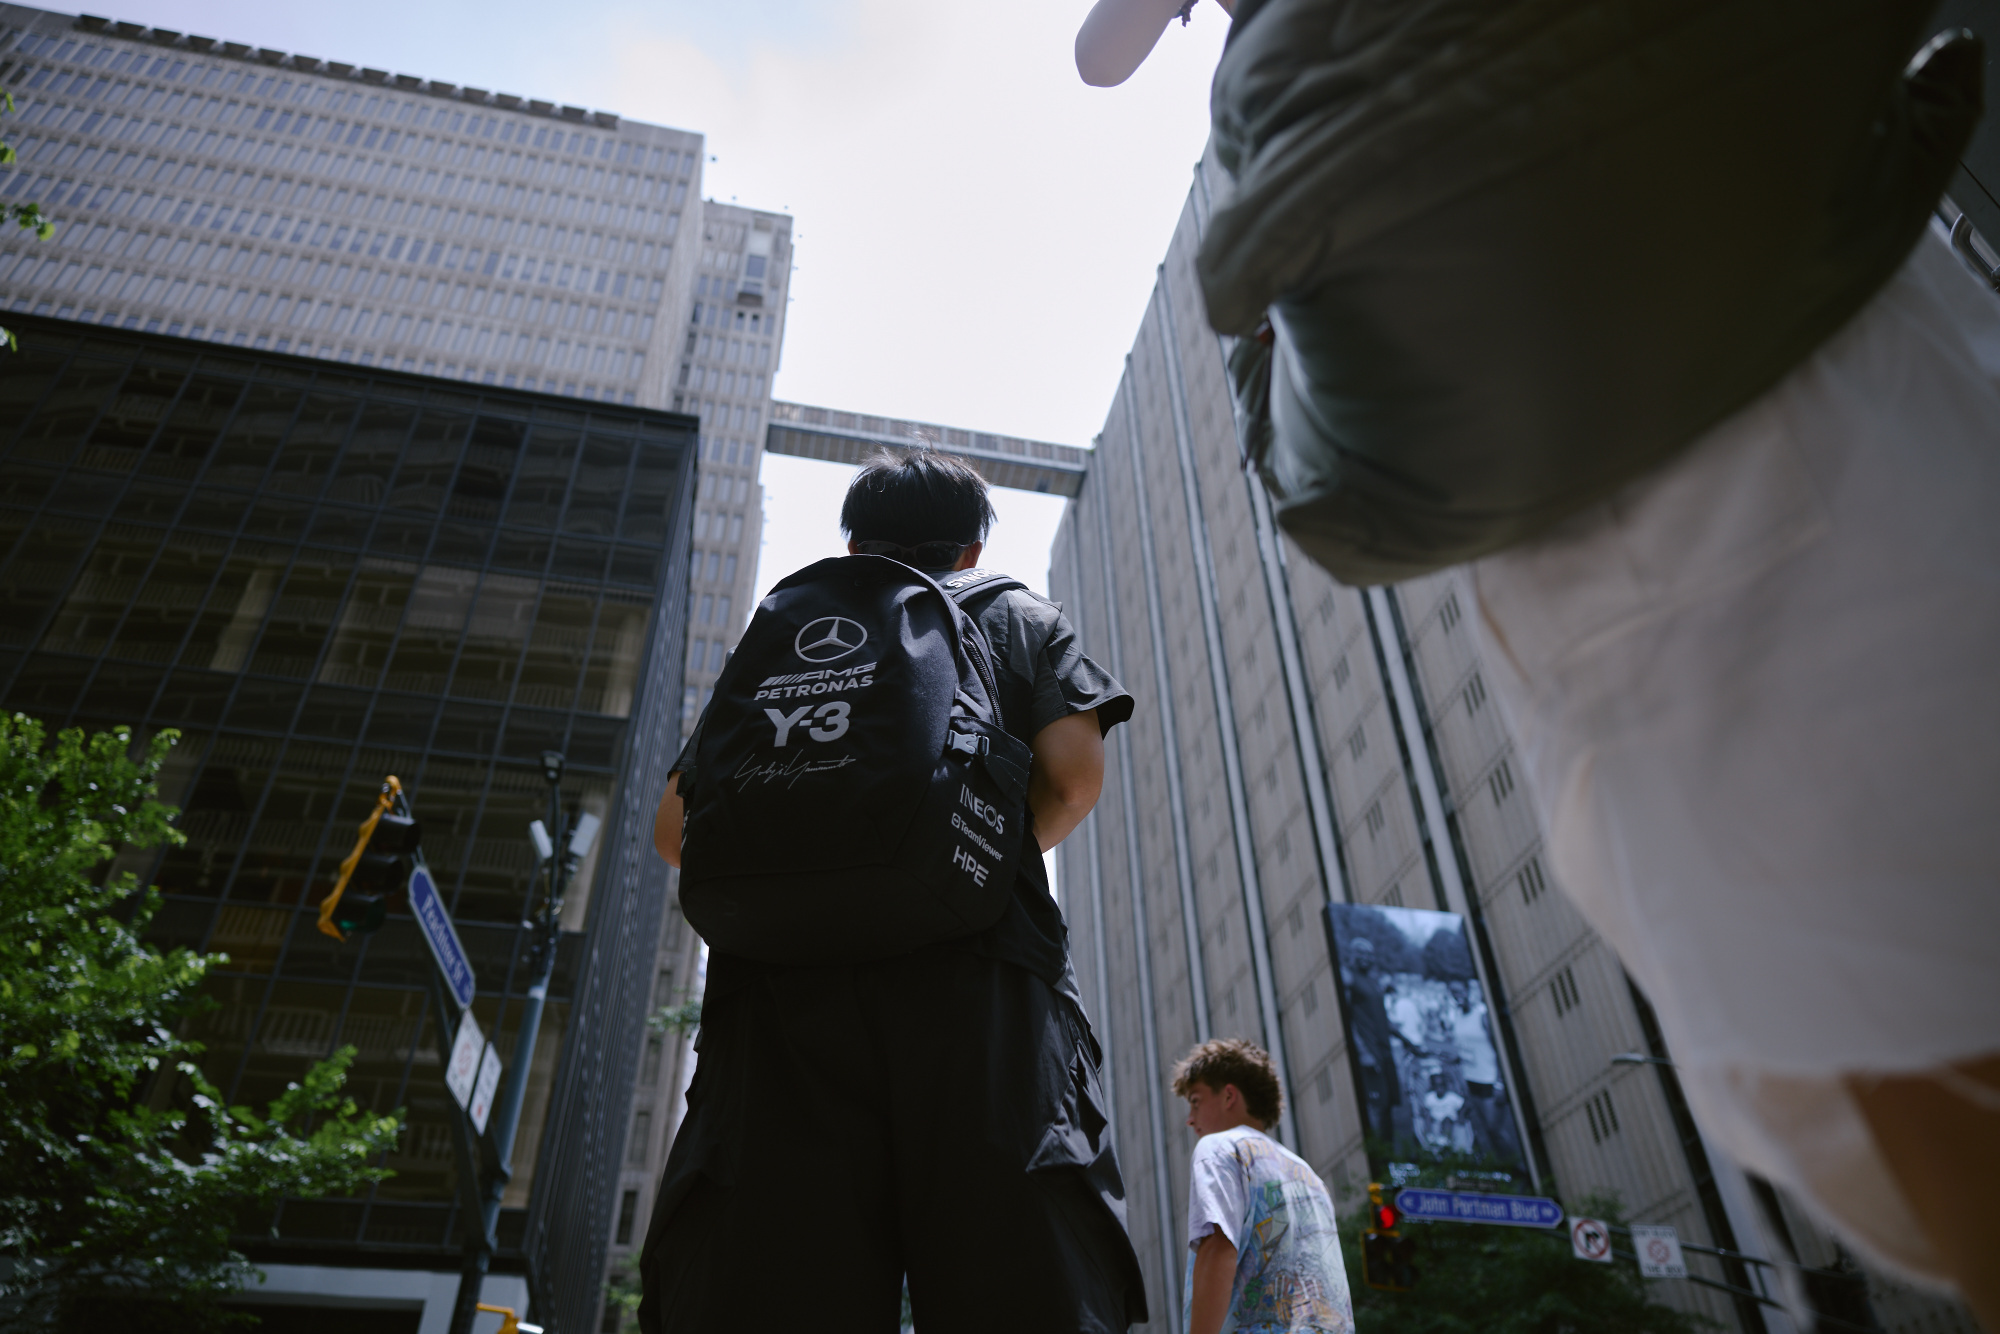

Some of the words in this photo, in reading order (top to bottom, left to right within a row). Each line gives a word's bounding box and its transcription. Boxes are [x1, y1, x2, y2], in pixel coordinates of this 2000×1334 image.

[753, 673, 874, 701] PETRONAS
[763, 700, 851, 748] Y-3
[959, 783, 1005, 835] INEOS
[960, 820, 1004, 862] TeamViewer
[952, 845, 990, 888] HPE
[1417, 1194, 1449, 1214] John
[1452, 1196, 1508, 1219] Portman
[1510, 1200, 1540, 1222] Blvd
